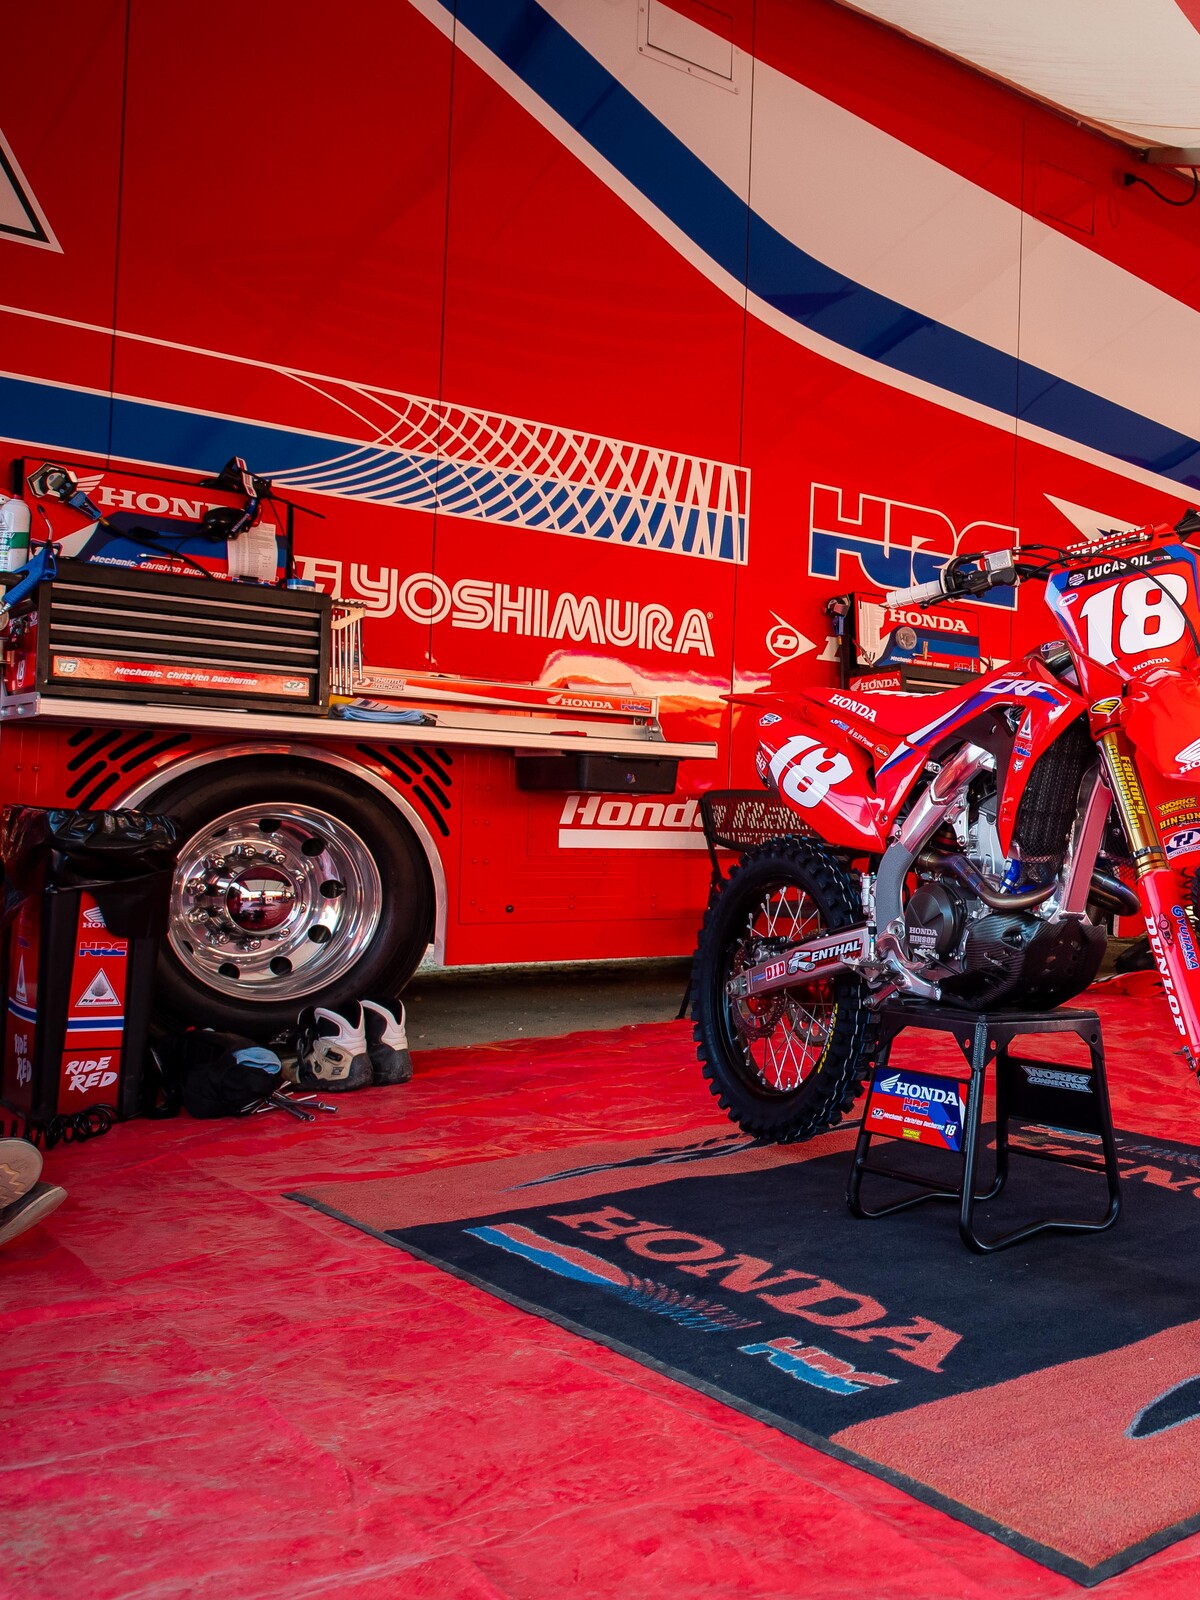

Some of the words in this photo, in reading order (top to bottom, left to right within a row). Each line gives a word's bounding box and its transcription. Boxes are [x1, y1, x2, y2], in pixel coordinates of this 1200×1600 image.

[98, 485, 229, 518] HON
[1087, 561, 1128, 580] LUCAS
[1130, 555, 1153, 568] OIL
[350, 562, 715, 658] YOSHIMURA
[889, 608, 970, 633] HONDA
[1080, 573, 1189, 666] 18
[58, 662, 76, 673] 18
[1132, 657, 1171, 672] HONDA
[860, 678, 900, 692] HONDA
[980, 678, 1056, 697] CRF
[561, 697, 614, 710] HONDA
[829, 694, 878, 723] HONDA
[769, 735, 853, 808] 18
[909, 926, 938, 937] HONDA
[79, 941, 128, 957] HRC
[787, 939, 864, 976] RENTHAL
[1144, 915, 1187, 1036] DUNLOP
[65, 1056, 112, 1075] RIDE
[1025, 1066, 1091, 1084] WORKS
[68, 1071, 118, 1094] RED
[895, 1080, 959, 1106] HONDA
[903, 1097, 930, 1116] HRC
[945, 1123, 957, 1137] 18
[548, 1205, 963, 1373] HONDA
[737, 1335, 901, 1395] HRC
